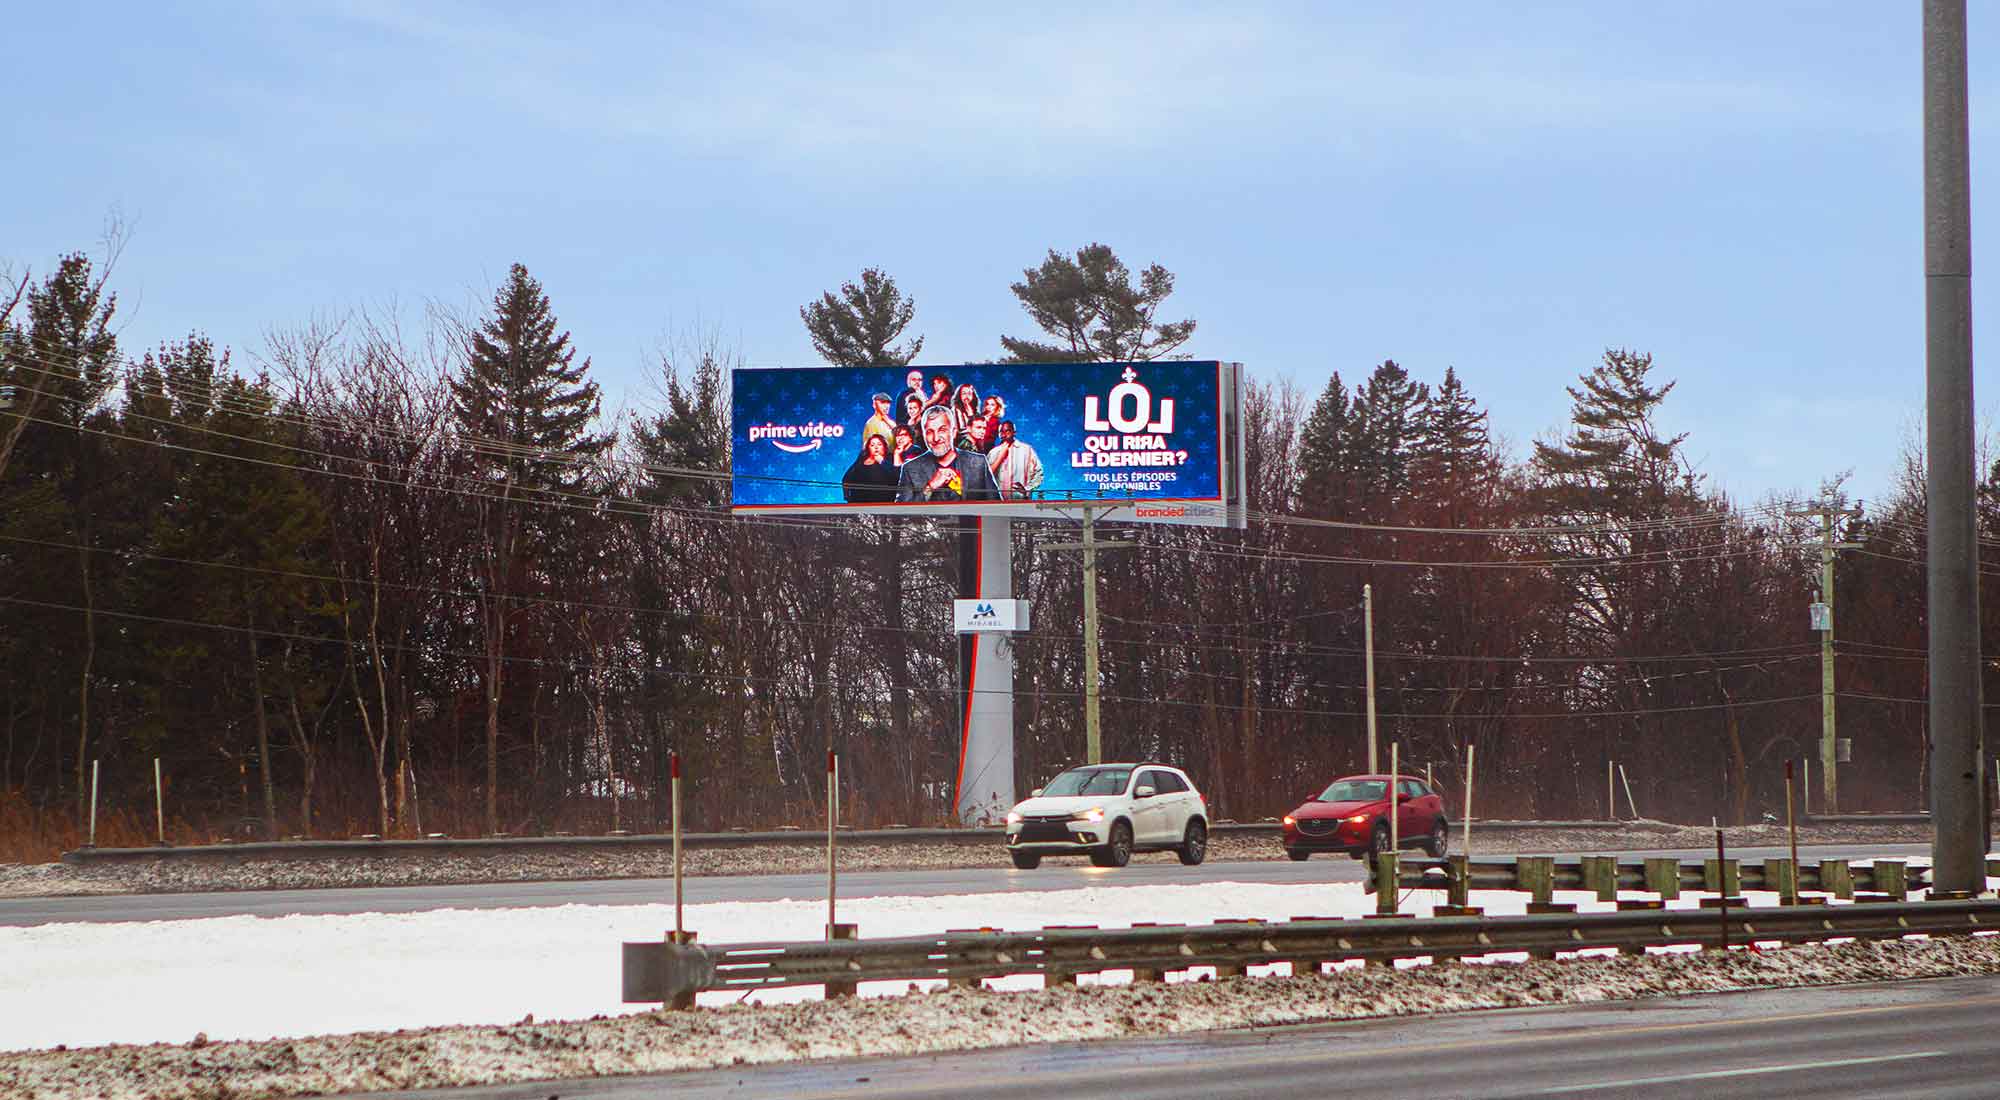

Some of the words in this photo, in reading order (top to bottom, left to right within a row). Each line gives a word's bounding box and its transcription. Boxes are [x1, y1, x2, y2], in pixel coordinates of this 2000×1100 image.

[749, 422, 797, 442] prime
[799, 422, 844, 437] video
[1084, 435, 1119, 453] QUI
[1122, 435, 1167, 450] RIRA
[1071, 452, 1094, 468] LE
[1096, 450, 1188, 467] DERNIER?
[1084, 473, 1109, 482] TOUS
[1111, 473, 1129, 482] LES
[1131, 472, 1177, 482] ÉPISODES
[1099, 482, 1161, 490] DISPONIBLES
